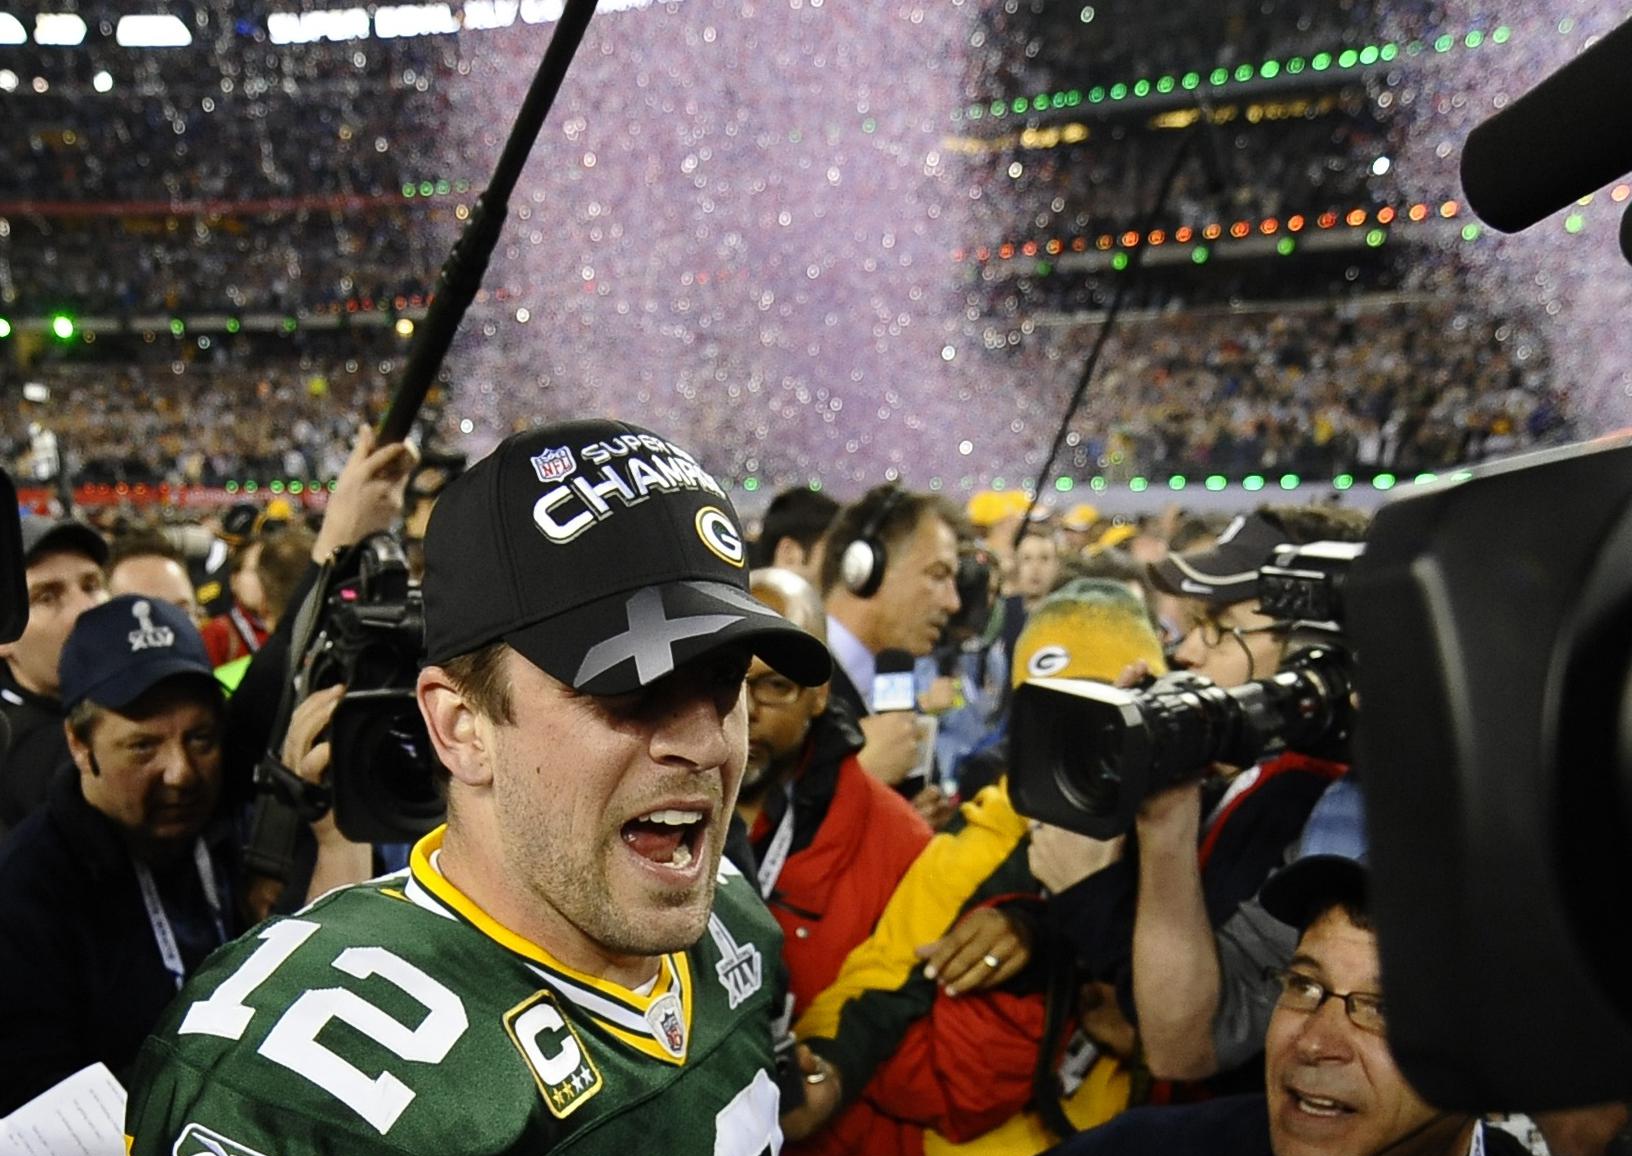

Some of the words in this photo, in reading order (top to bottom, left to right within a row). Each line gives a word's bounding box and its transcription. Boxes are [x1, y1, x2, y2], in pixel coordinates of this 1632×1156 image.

[540, 458, 571, 478] NFL
[581, 434, 672, 465] SUPER
[532, 455, 727, 545] CHAMP
[695, 505, 745, 568] G
[718, 952, 763, 1010] XLV
[178, 918, 469, 1135] 12
[521, 1002, 583, 1086] C
